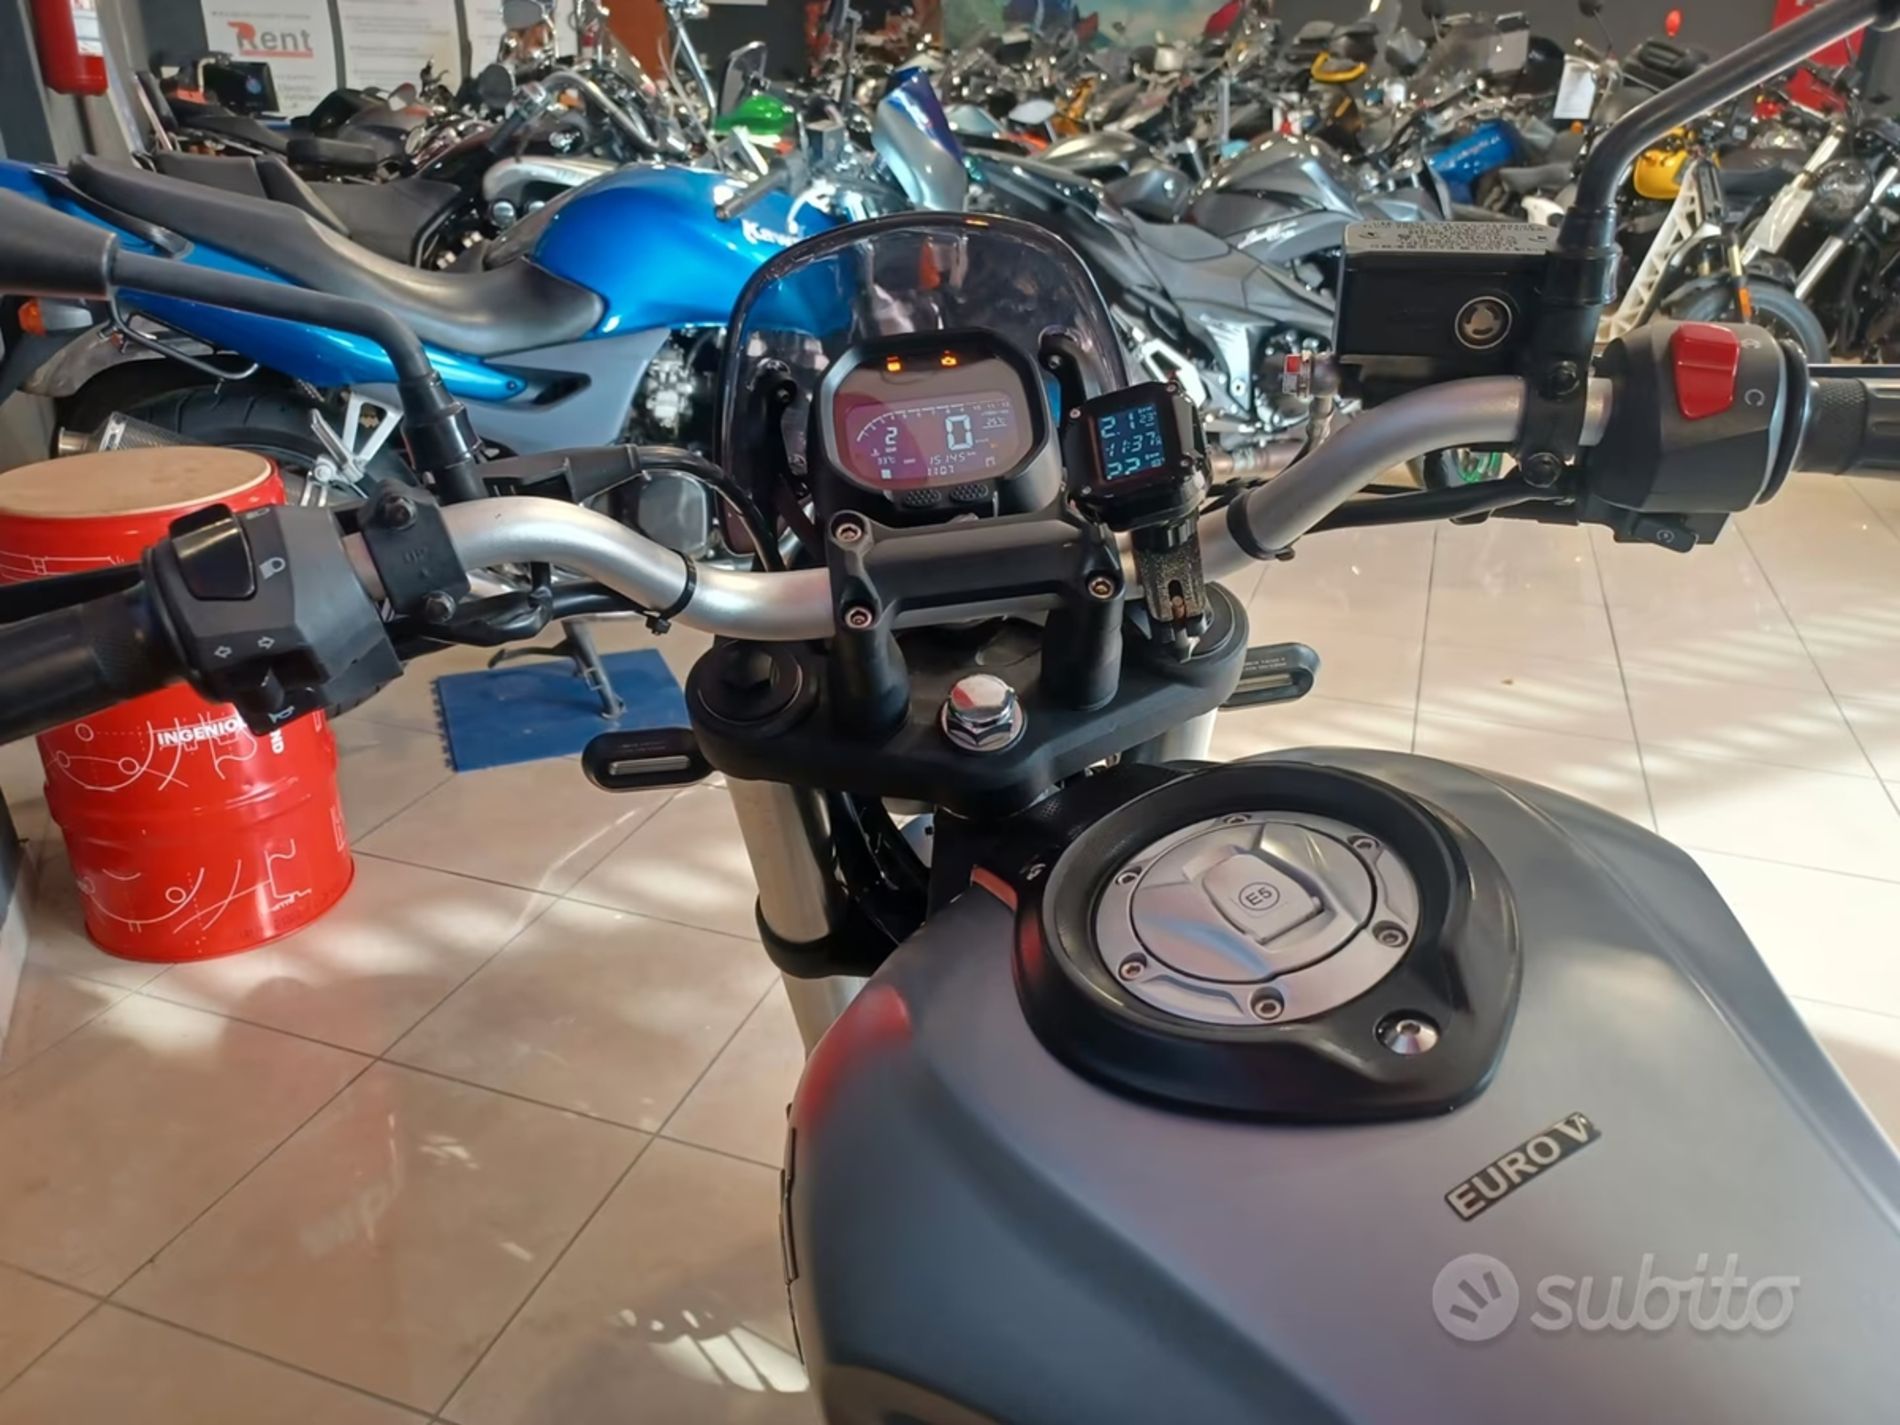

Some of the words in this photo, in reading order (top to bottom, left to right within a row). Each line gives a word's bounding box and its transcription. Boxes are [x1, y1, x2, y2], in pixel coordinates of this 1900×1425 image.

[228, 21, 312, 52] Rent
[945, 414, 973, 451] 0
[157, 717, 247, 746] INGENIO
[1245, 886, 1273, 906] E5
[1447, 1135, 1560, 1219] EURO
[1554, 1113, 1593, 1142] V
